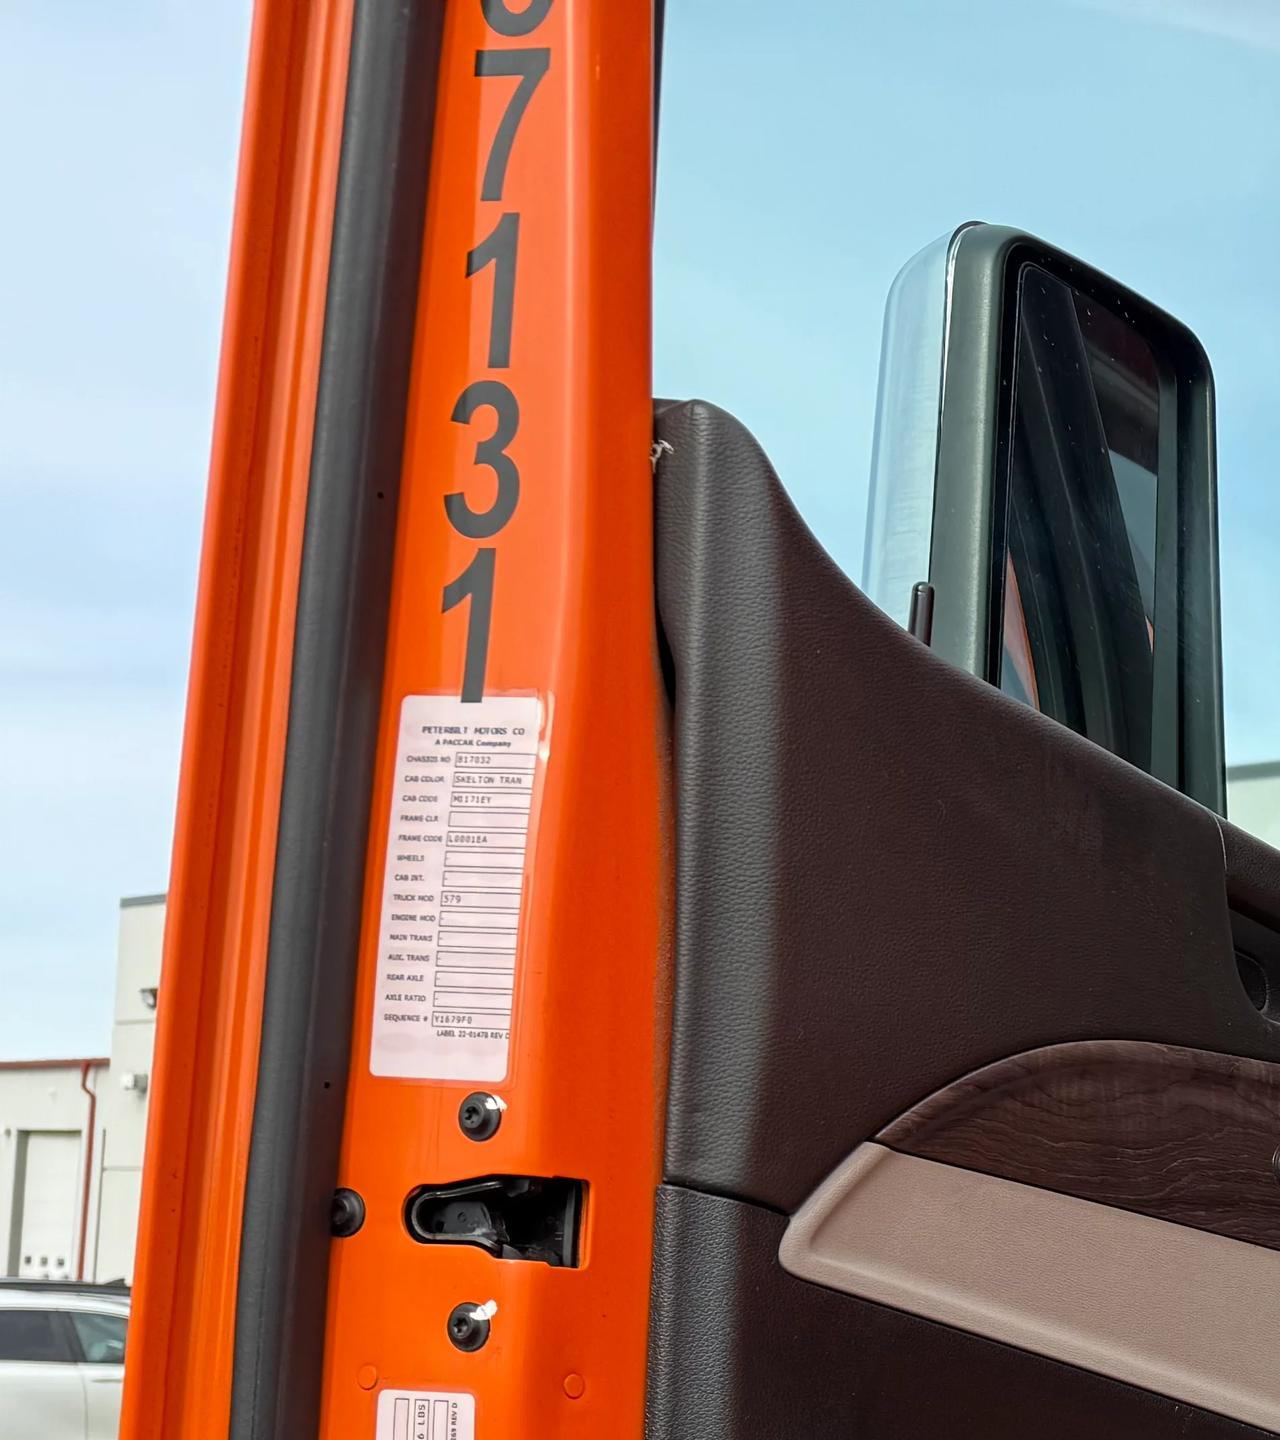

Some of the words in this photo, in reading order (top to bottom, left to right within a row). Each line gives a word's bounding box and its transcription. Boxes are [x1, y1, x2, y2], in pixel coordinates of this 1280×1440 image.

[422, 726, 467, 734] PETERBILT
[475, 727, 507, 735] MOTORS
[457, 756, 491, 764] 817032
[444, 895, 461, 903] 579
[384, 1014, 420, 1022] SEQUENCE
